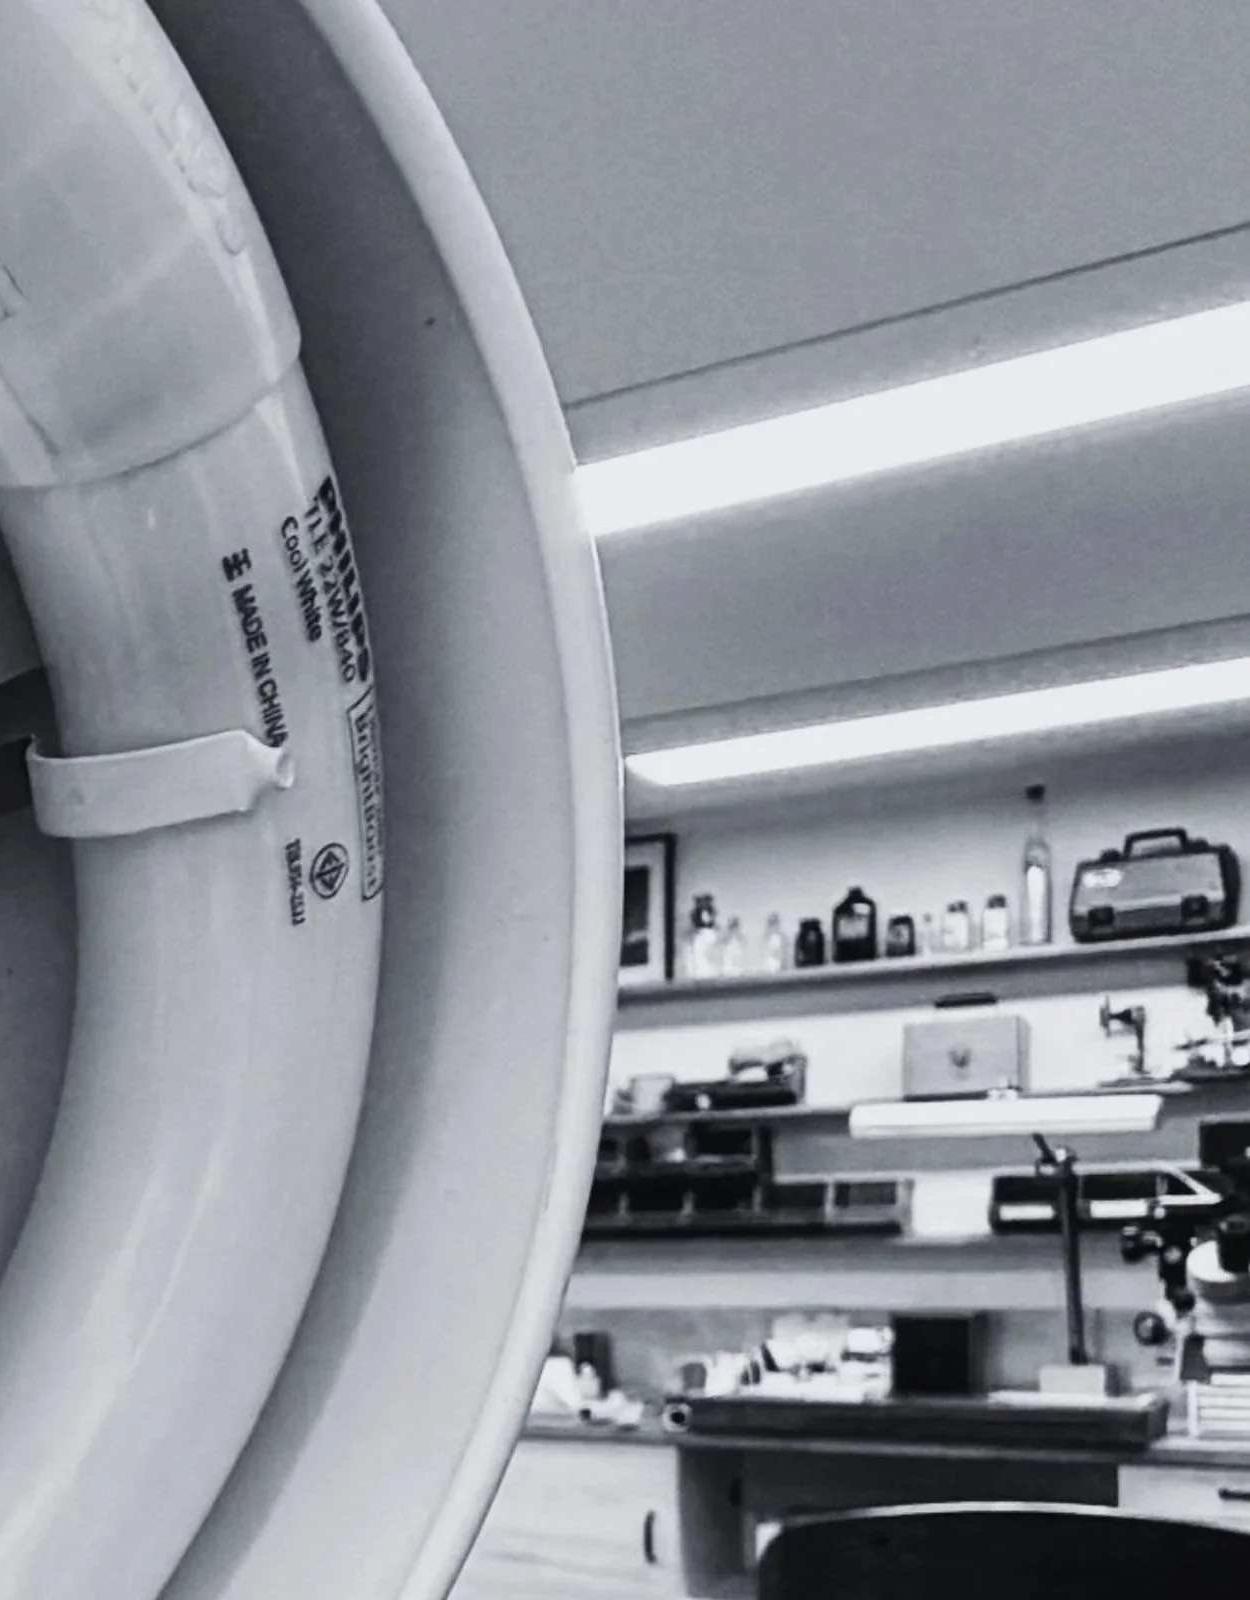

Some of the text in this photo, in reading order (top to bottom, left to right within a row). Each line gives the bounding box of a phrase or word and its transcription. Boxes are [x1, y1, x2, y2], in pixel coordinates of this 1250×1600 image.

[280, 515, 323, 643] Cool White
[232, 583, 268, 654] MADE
[251, 651, 273, 681] IN
[257, 678, 289, 749] CHINA
